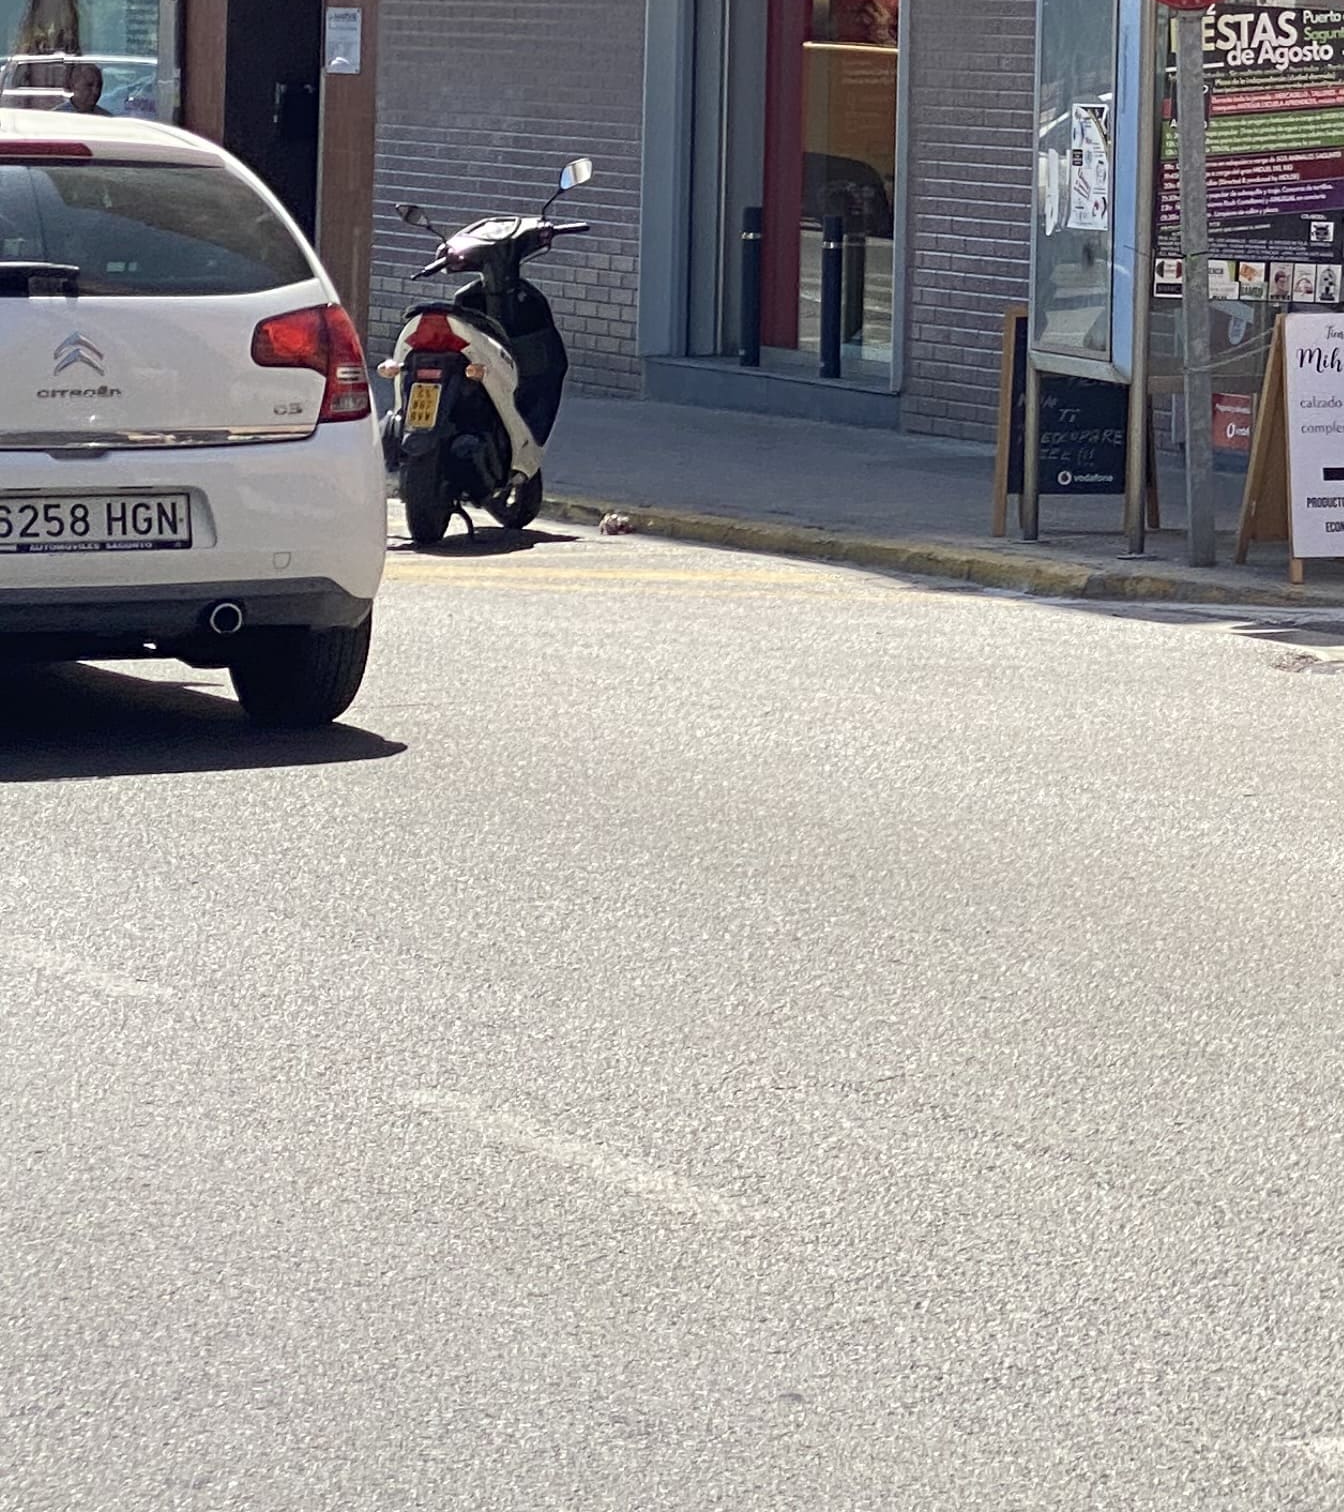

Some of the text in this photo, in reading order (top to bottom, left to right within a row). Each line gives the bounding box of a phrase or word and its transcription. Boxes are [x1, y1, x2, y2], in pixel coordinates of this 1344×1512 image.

[1303, 10, 1341, 24] Puerto
[1227, 41, 1334, 71] de Agosto
[273, 402, 303, 416] C3
[1300, 395, 1342, 409] calzado
[1073, 473, 1114, 483] vodafone
[106, 501, 178, 536] HGN
[29, 543, 100, 552] AUTOMOVILES
